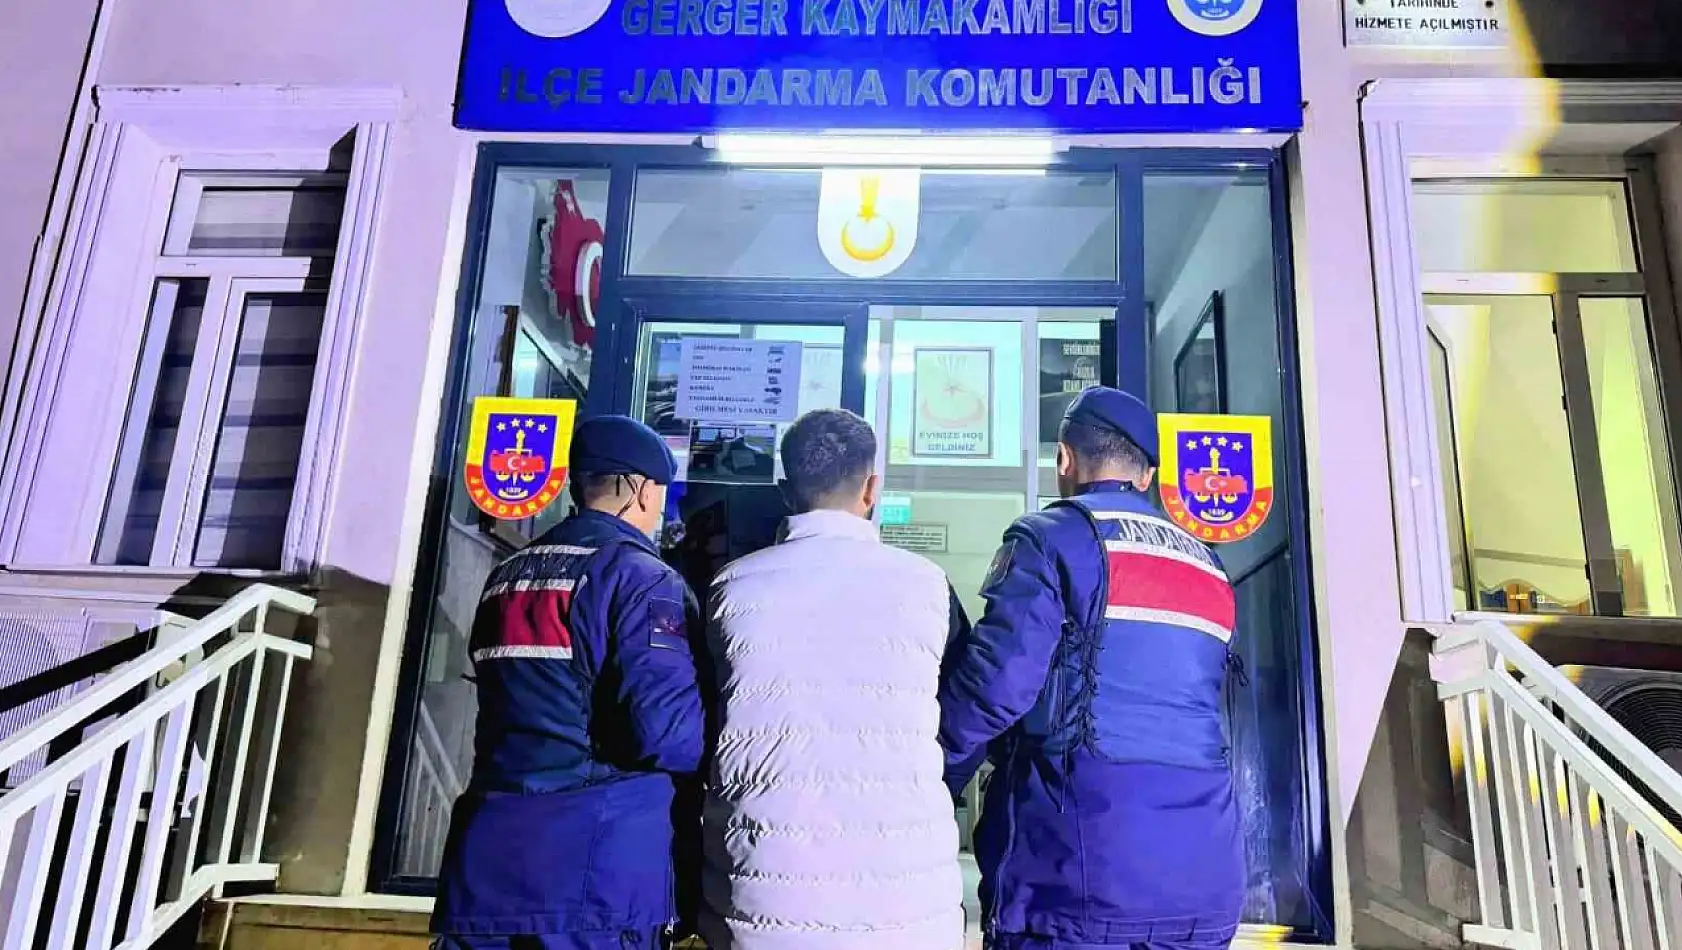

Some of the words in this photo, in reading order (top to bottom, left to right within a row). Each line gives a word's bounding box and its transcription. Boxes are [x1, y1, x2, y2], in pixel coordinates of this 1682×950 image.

[622, 0, 787, 36] GERGER
[1355, 14, 1412, 29] HİZMETE
[500, 66, 604, 109] İLÇE
[618, 68, 888, 106] JANDARMA
[906, 58, 1261, 106] KOMUTANLIĞI
[470, 475, 560, 516] JANDARMA
[1167, 496, 1266, 538] JANDARMA
